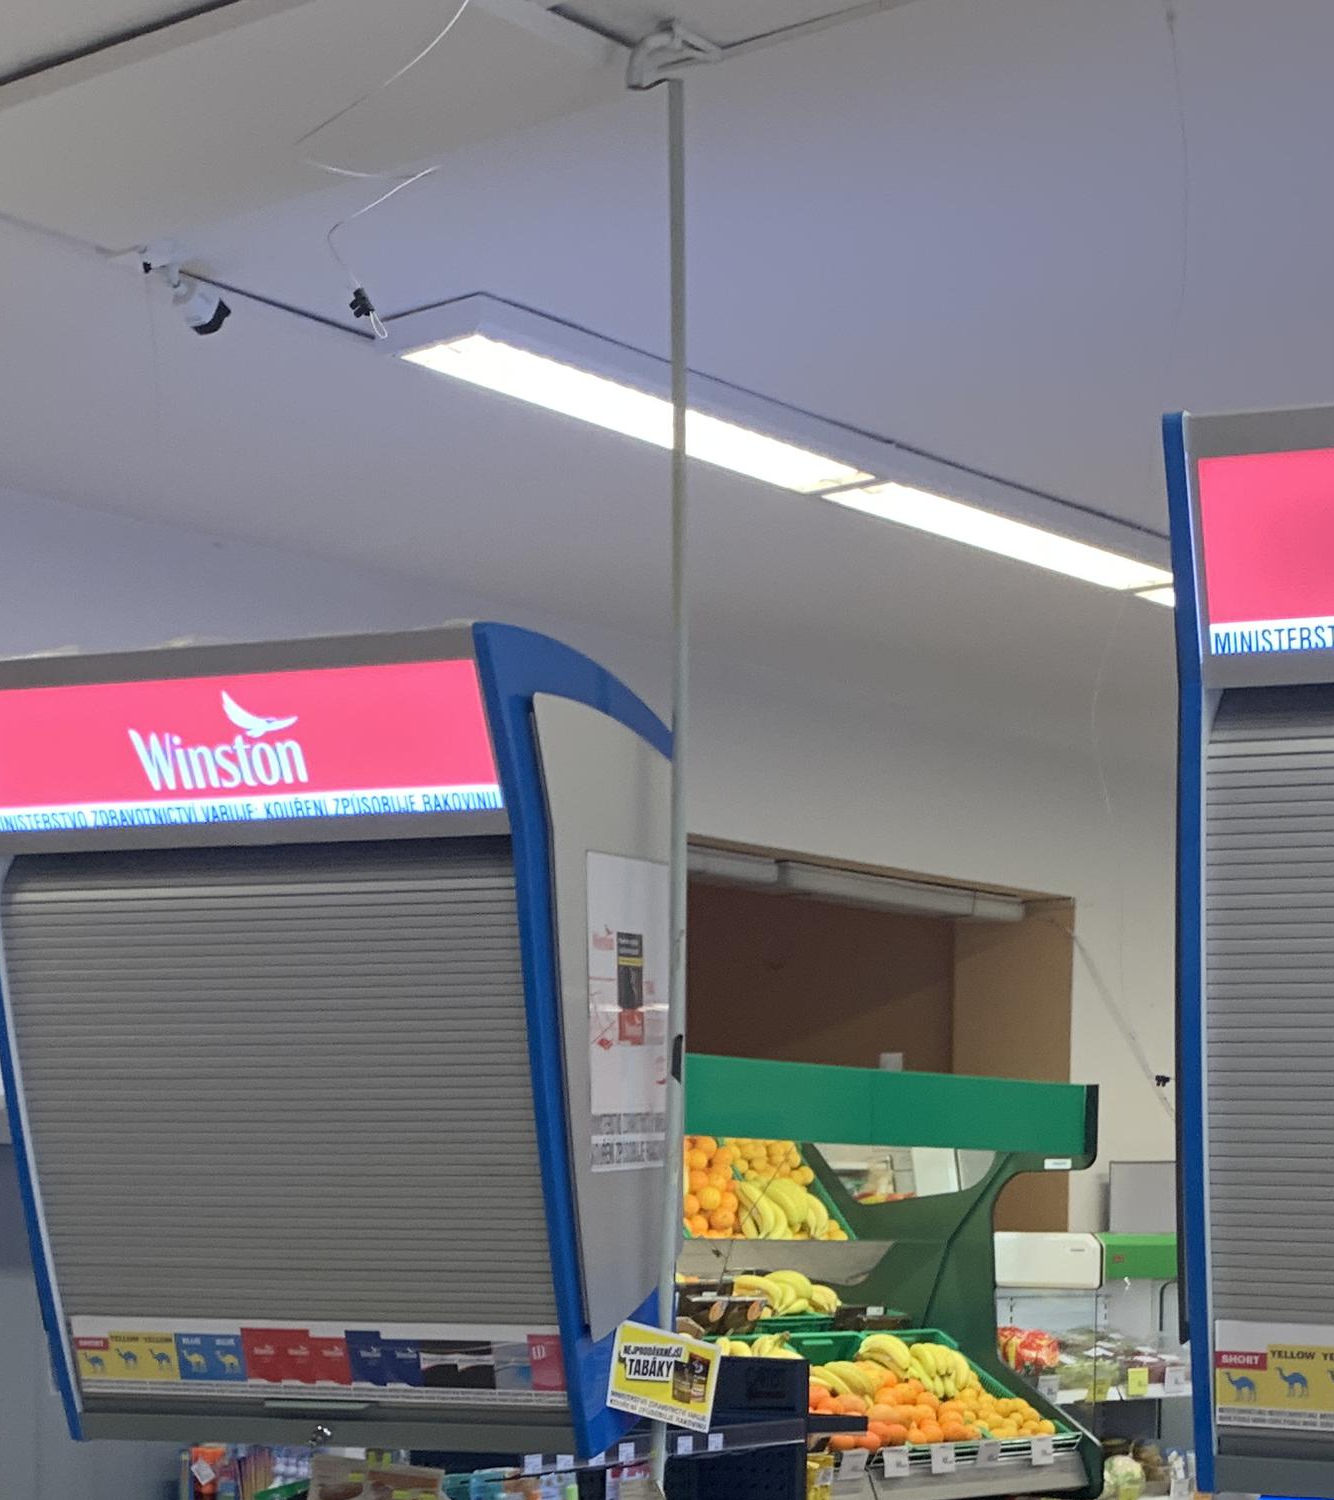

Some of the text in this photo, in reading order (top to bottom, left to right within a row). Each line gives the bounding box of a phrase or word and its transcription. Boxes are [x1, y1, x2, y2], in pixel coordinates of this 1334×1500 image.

[128, 729, 308, 792] Winston
[93, 803, 198, 829] ZDRAVOTNICTVÍ
[265, 798, 328, 821] KOUŘENÍ
[332, 793, 421, 817] ZPŮSOBUJE
[423, 790, 500, 812] RAKOVINU
[1220, 1354, 1260, 1365] SHORT
[1269, 1349, 1316, 1361] YELLOW
[628, 1356, 673, 1378] TABÁKY
